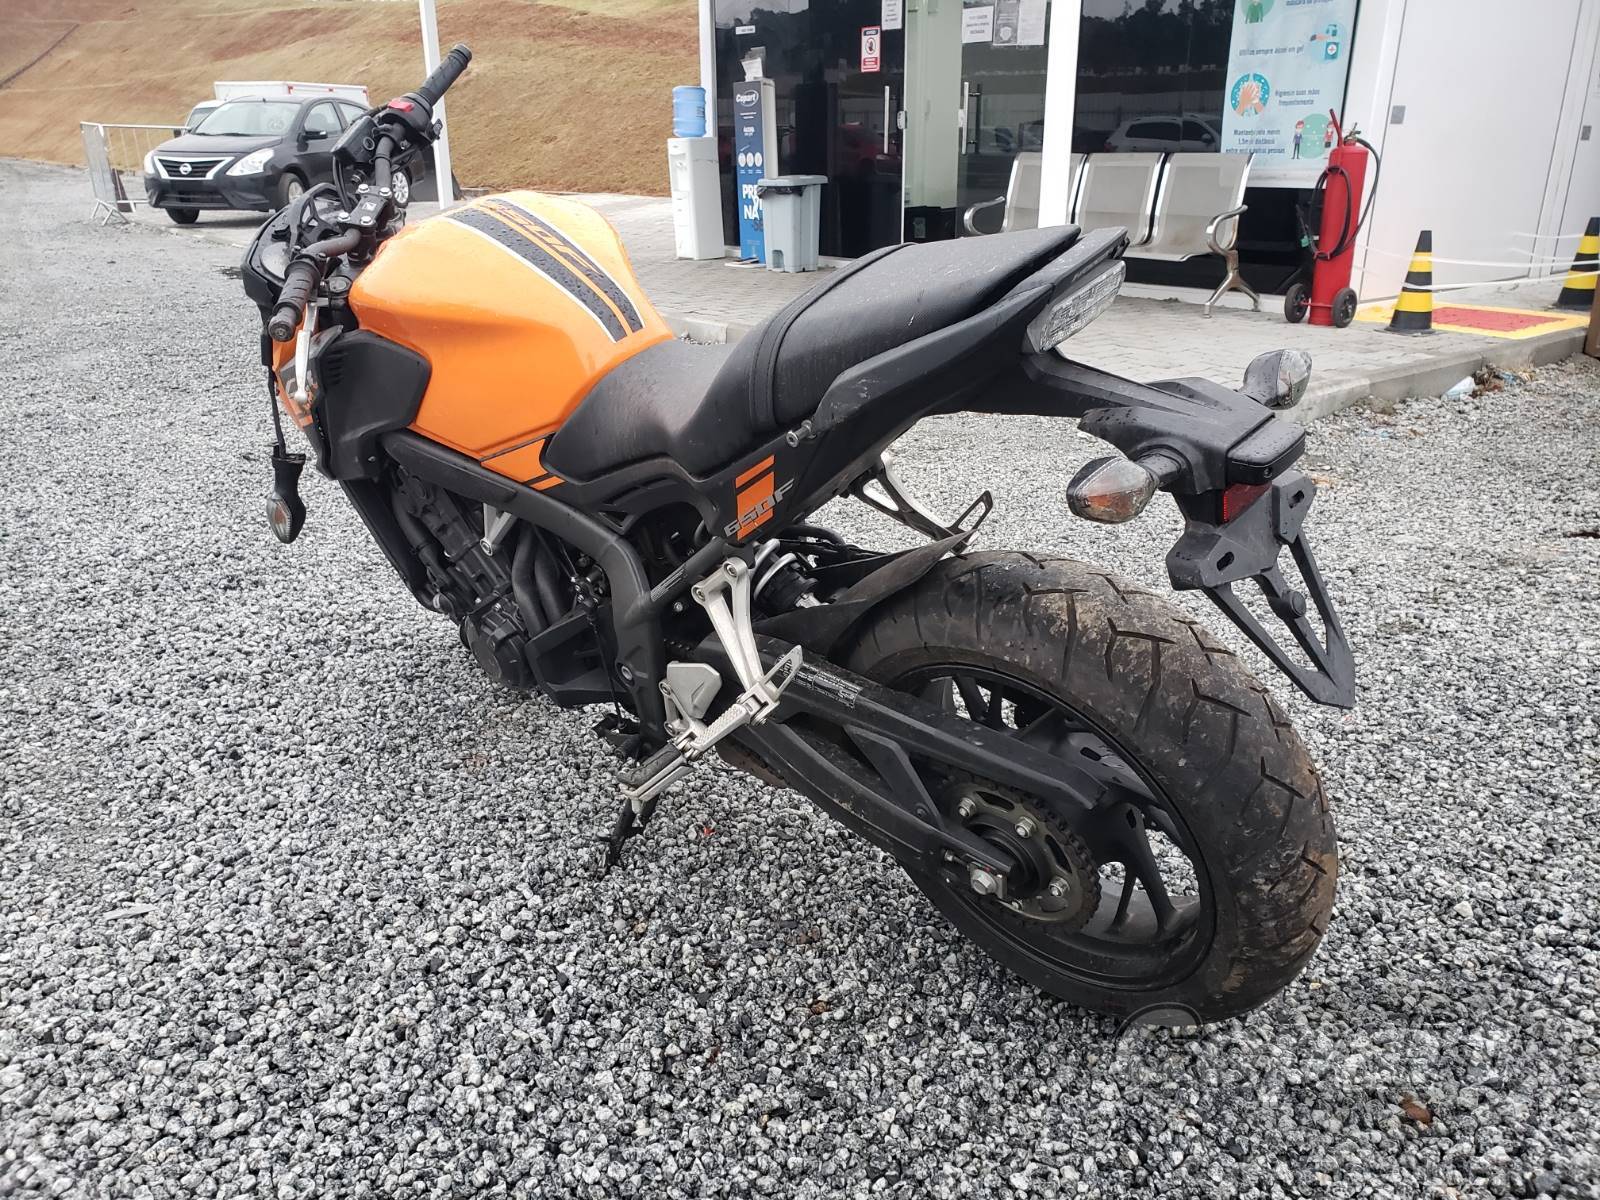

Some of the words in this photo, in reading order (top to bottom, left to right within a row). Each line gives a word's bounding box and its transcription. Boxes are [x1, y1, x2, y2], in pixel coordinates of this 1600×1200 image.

[736, 93, 756, 104] Copart
[743, 205, 760, 221] NA
[723, 478, 795, 537] 650F
